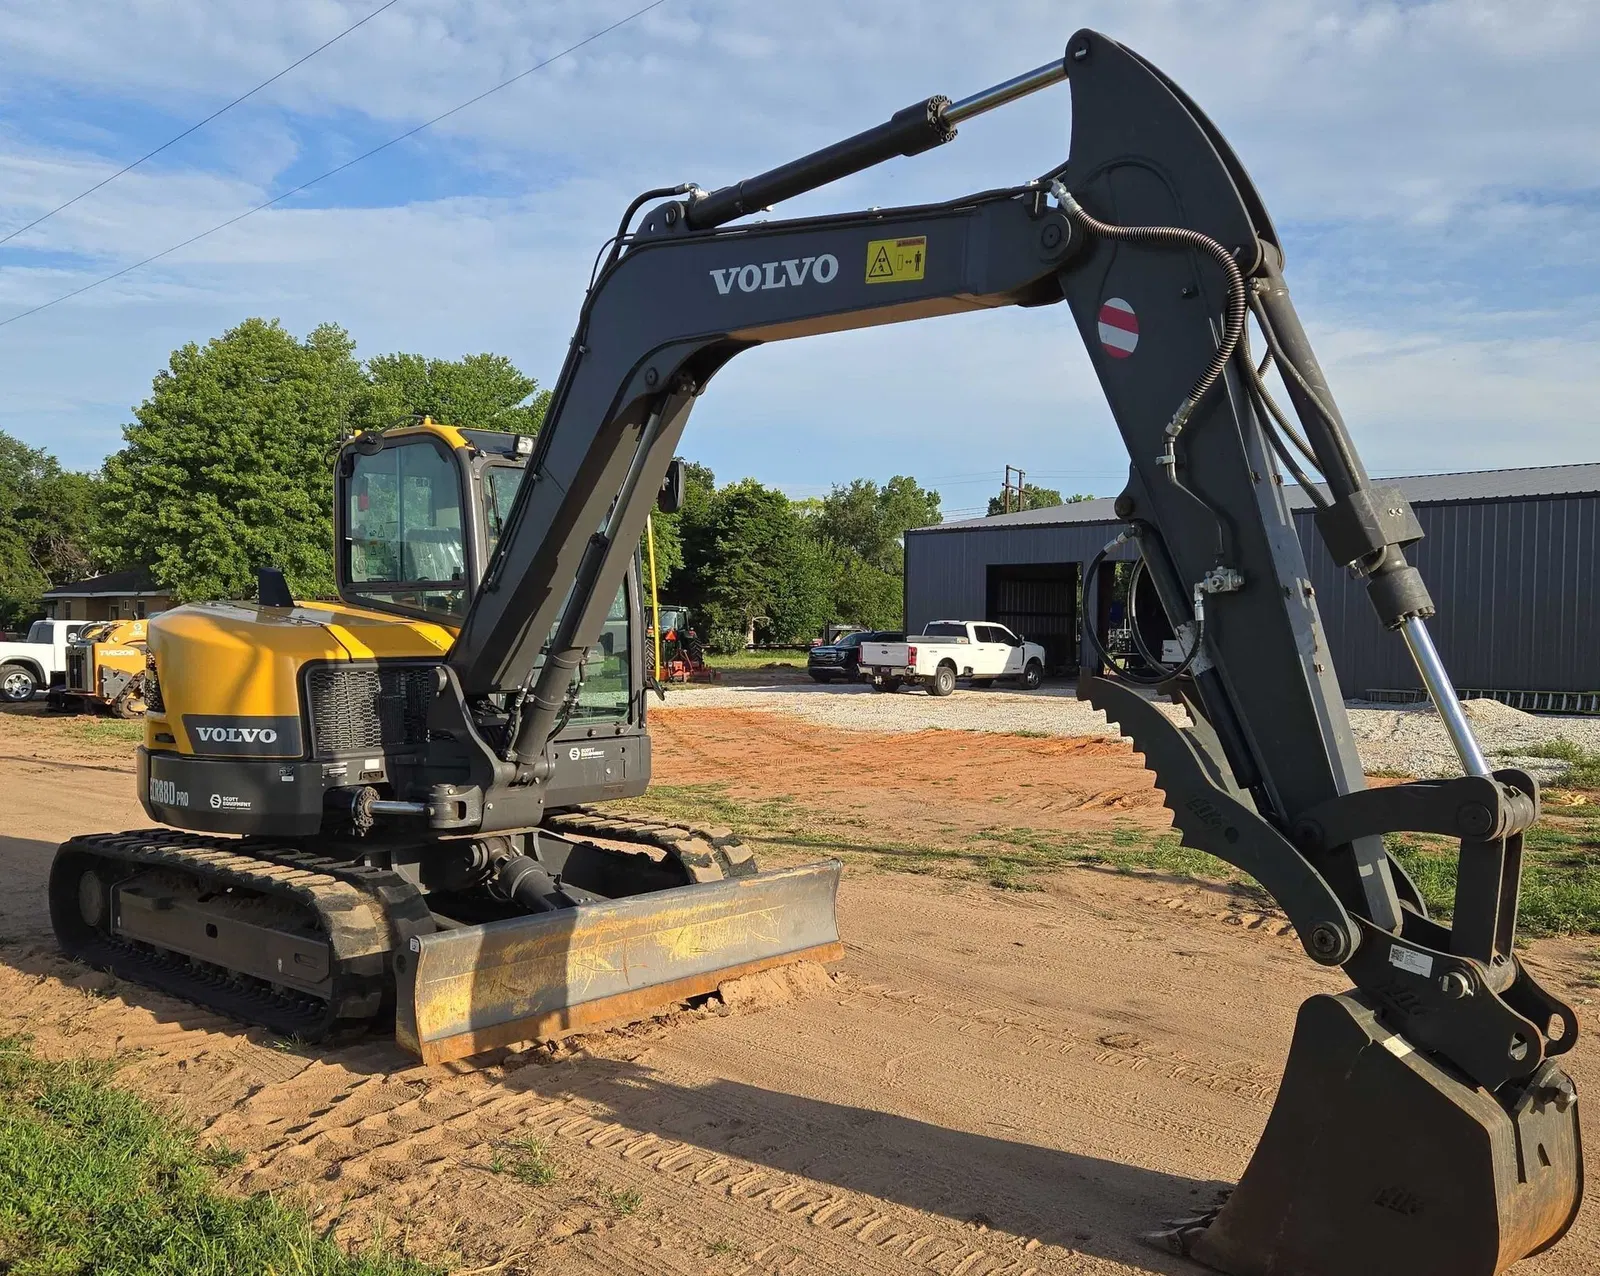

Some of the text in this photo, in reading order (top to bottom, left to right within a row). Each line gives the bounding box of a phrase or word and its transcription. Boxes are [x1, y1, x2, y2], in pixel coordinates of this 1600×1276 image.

[709, 253, 839, 294] VOLVO
[195, 727, 277, 743] VOLVO
[176, 791, 189, 807] PRO
